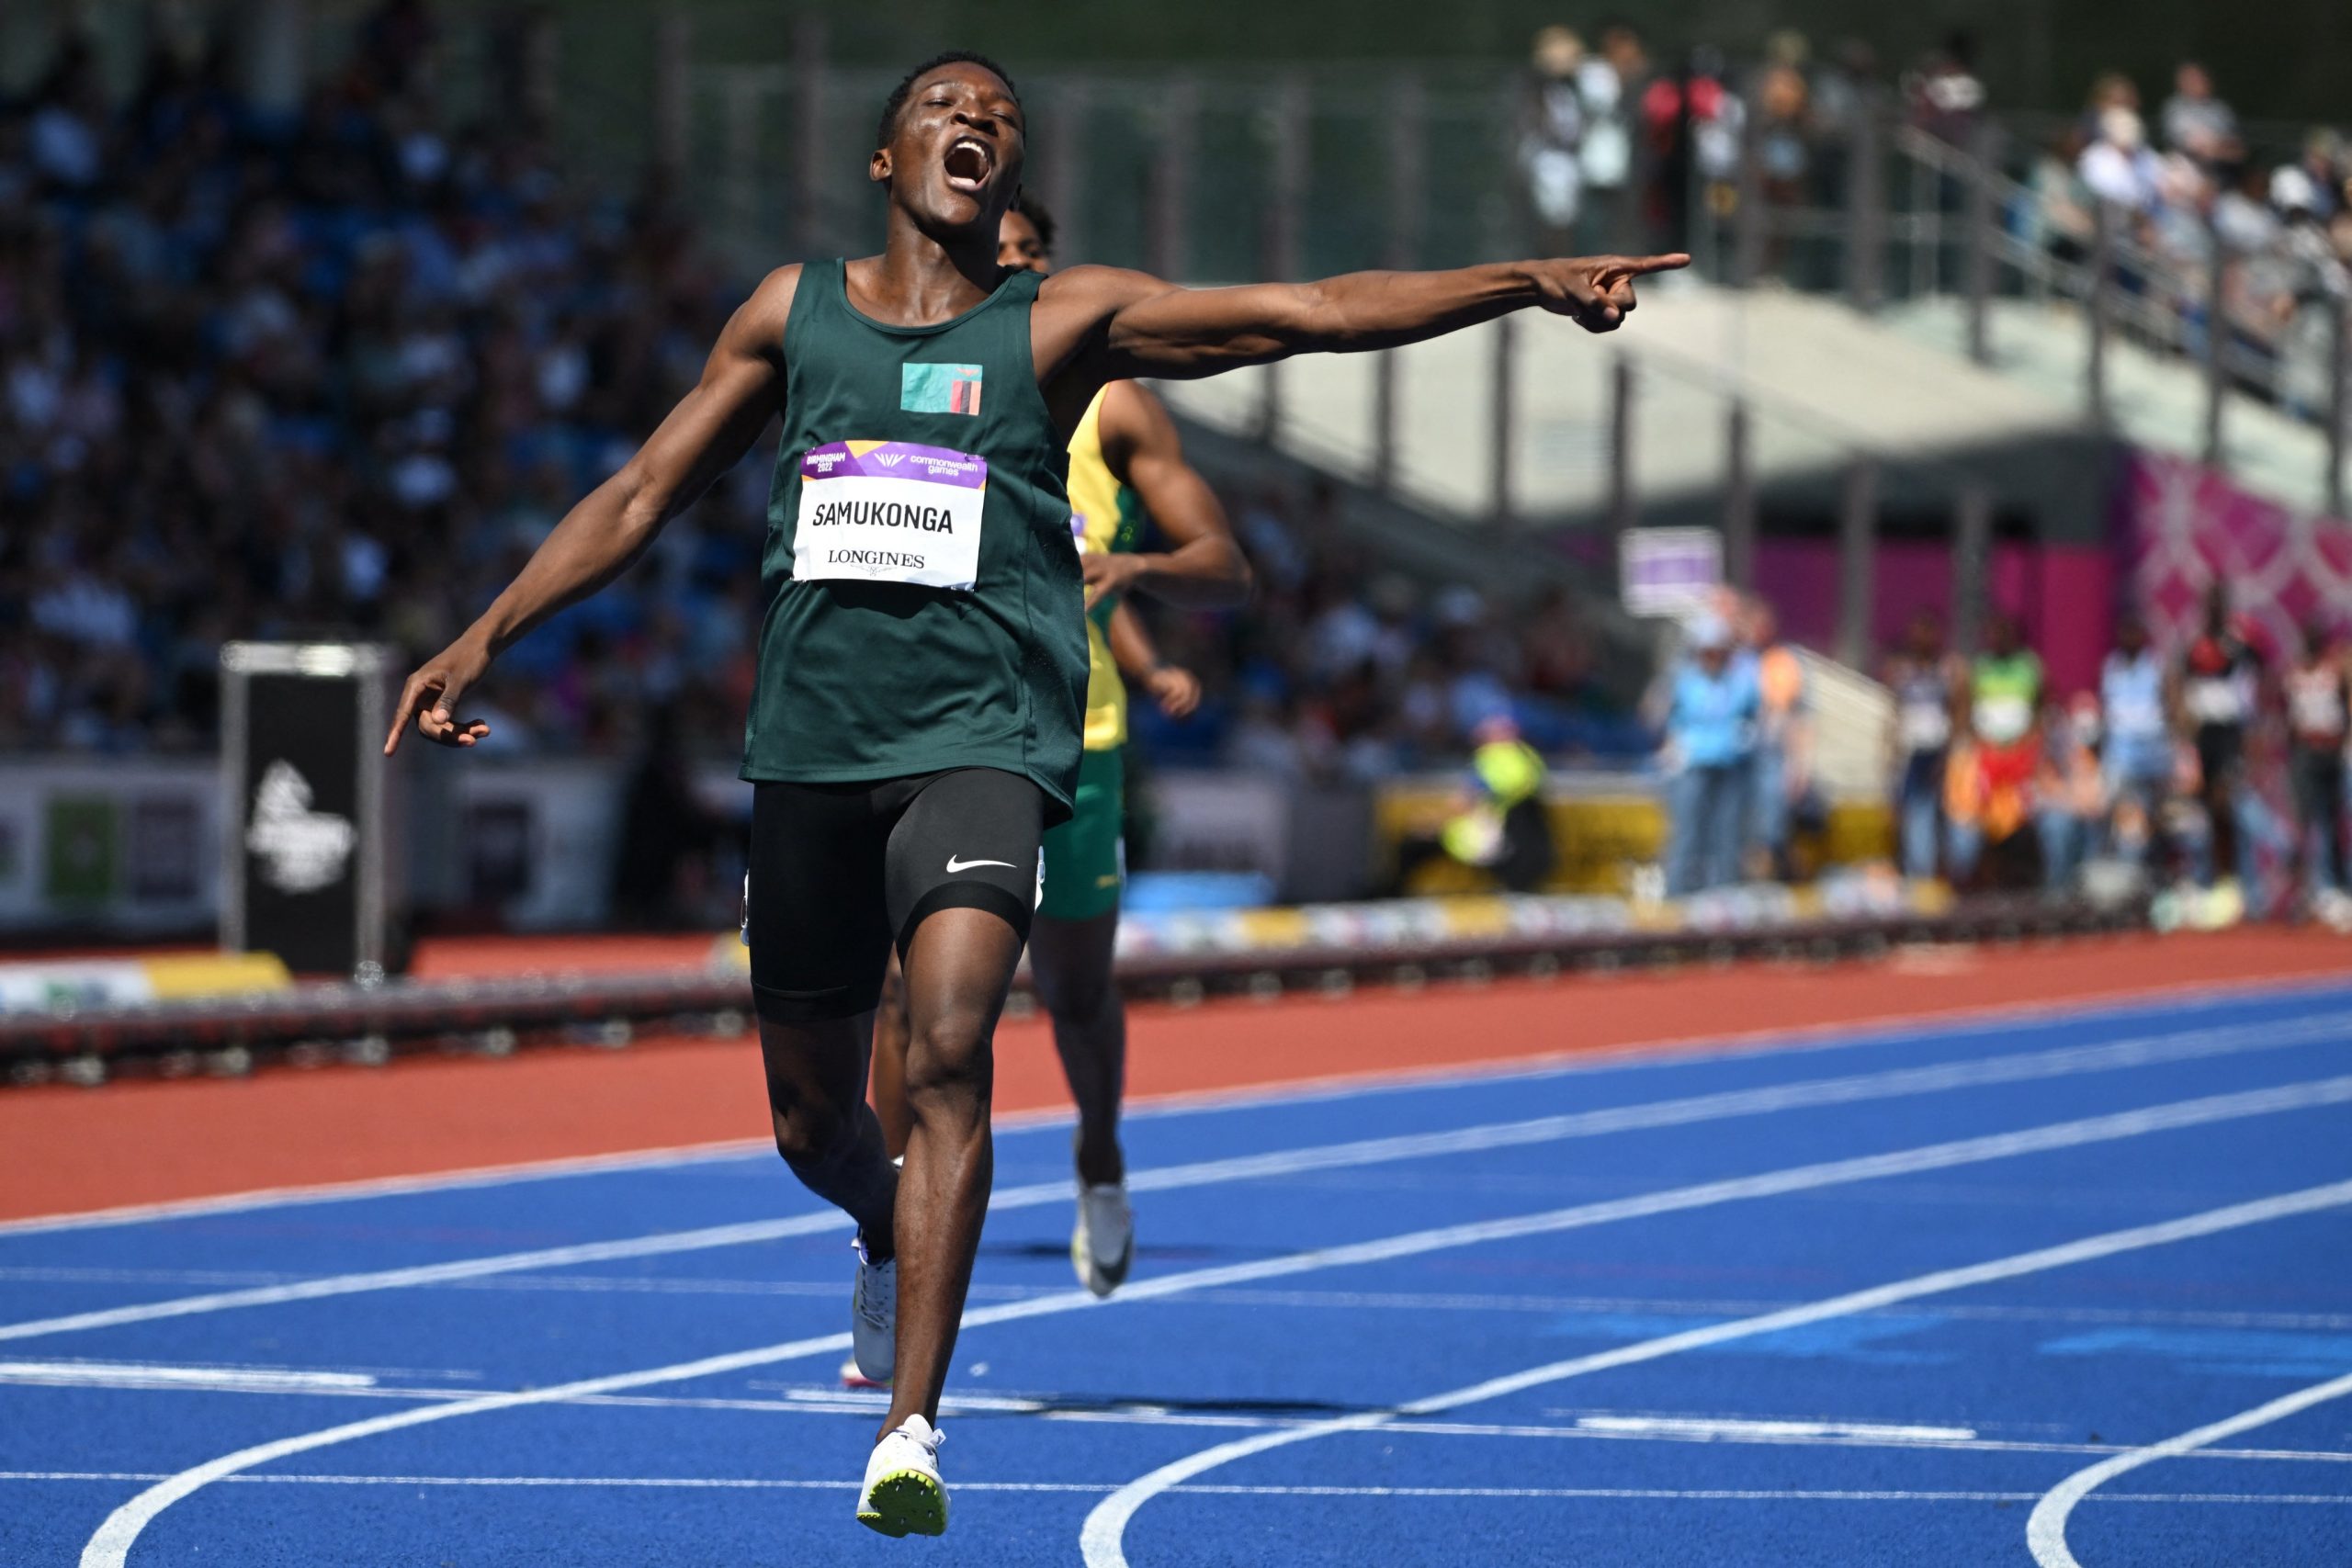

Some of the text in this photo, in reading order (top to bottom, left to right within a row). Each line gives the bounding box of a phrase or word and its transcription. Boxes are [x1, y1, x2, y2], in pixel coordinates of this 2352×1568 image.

[807, 452, 845, 465] BIRMINGHAM
[910, 456, 978, 472] commonwealth
[818, 462, 833, 472] 2022
[928, 466, 959, 476] games
[812, 501, 954, 535] SAMUKONGA
[828, 549, 925, 570] LONGINES
